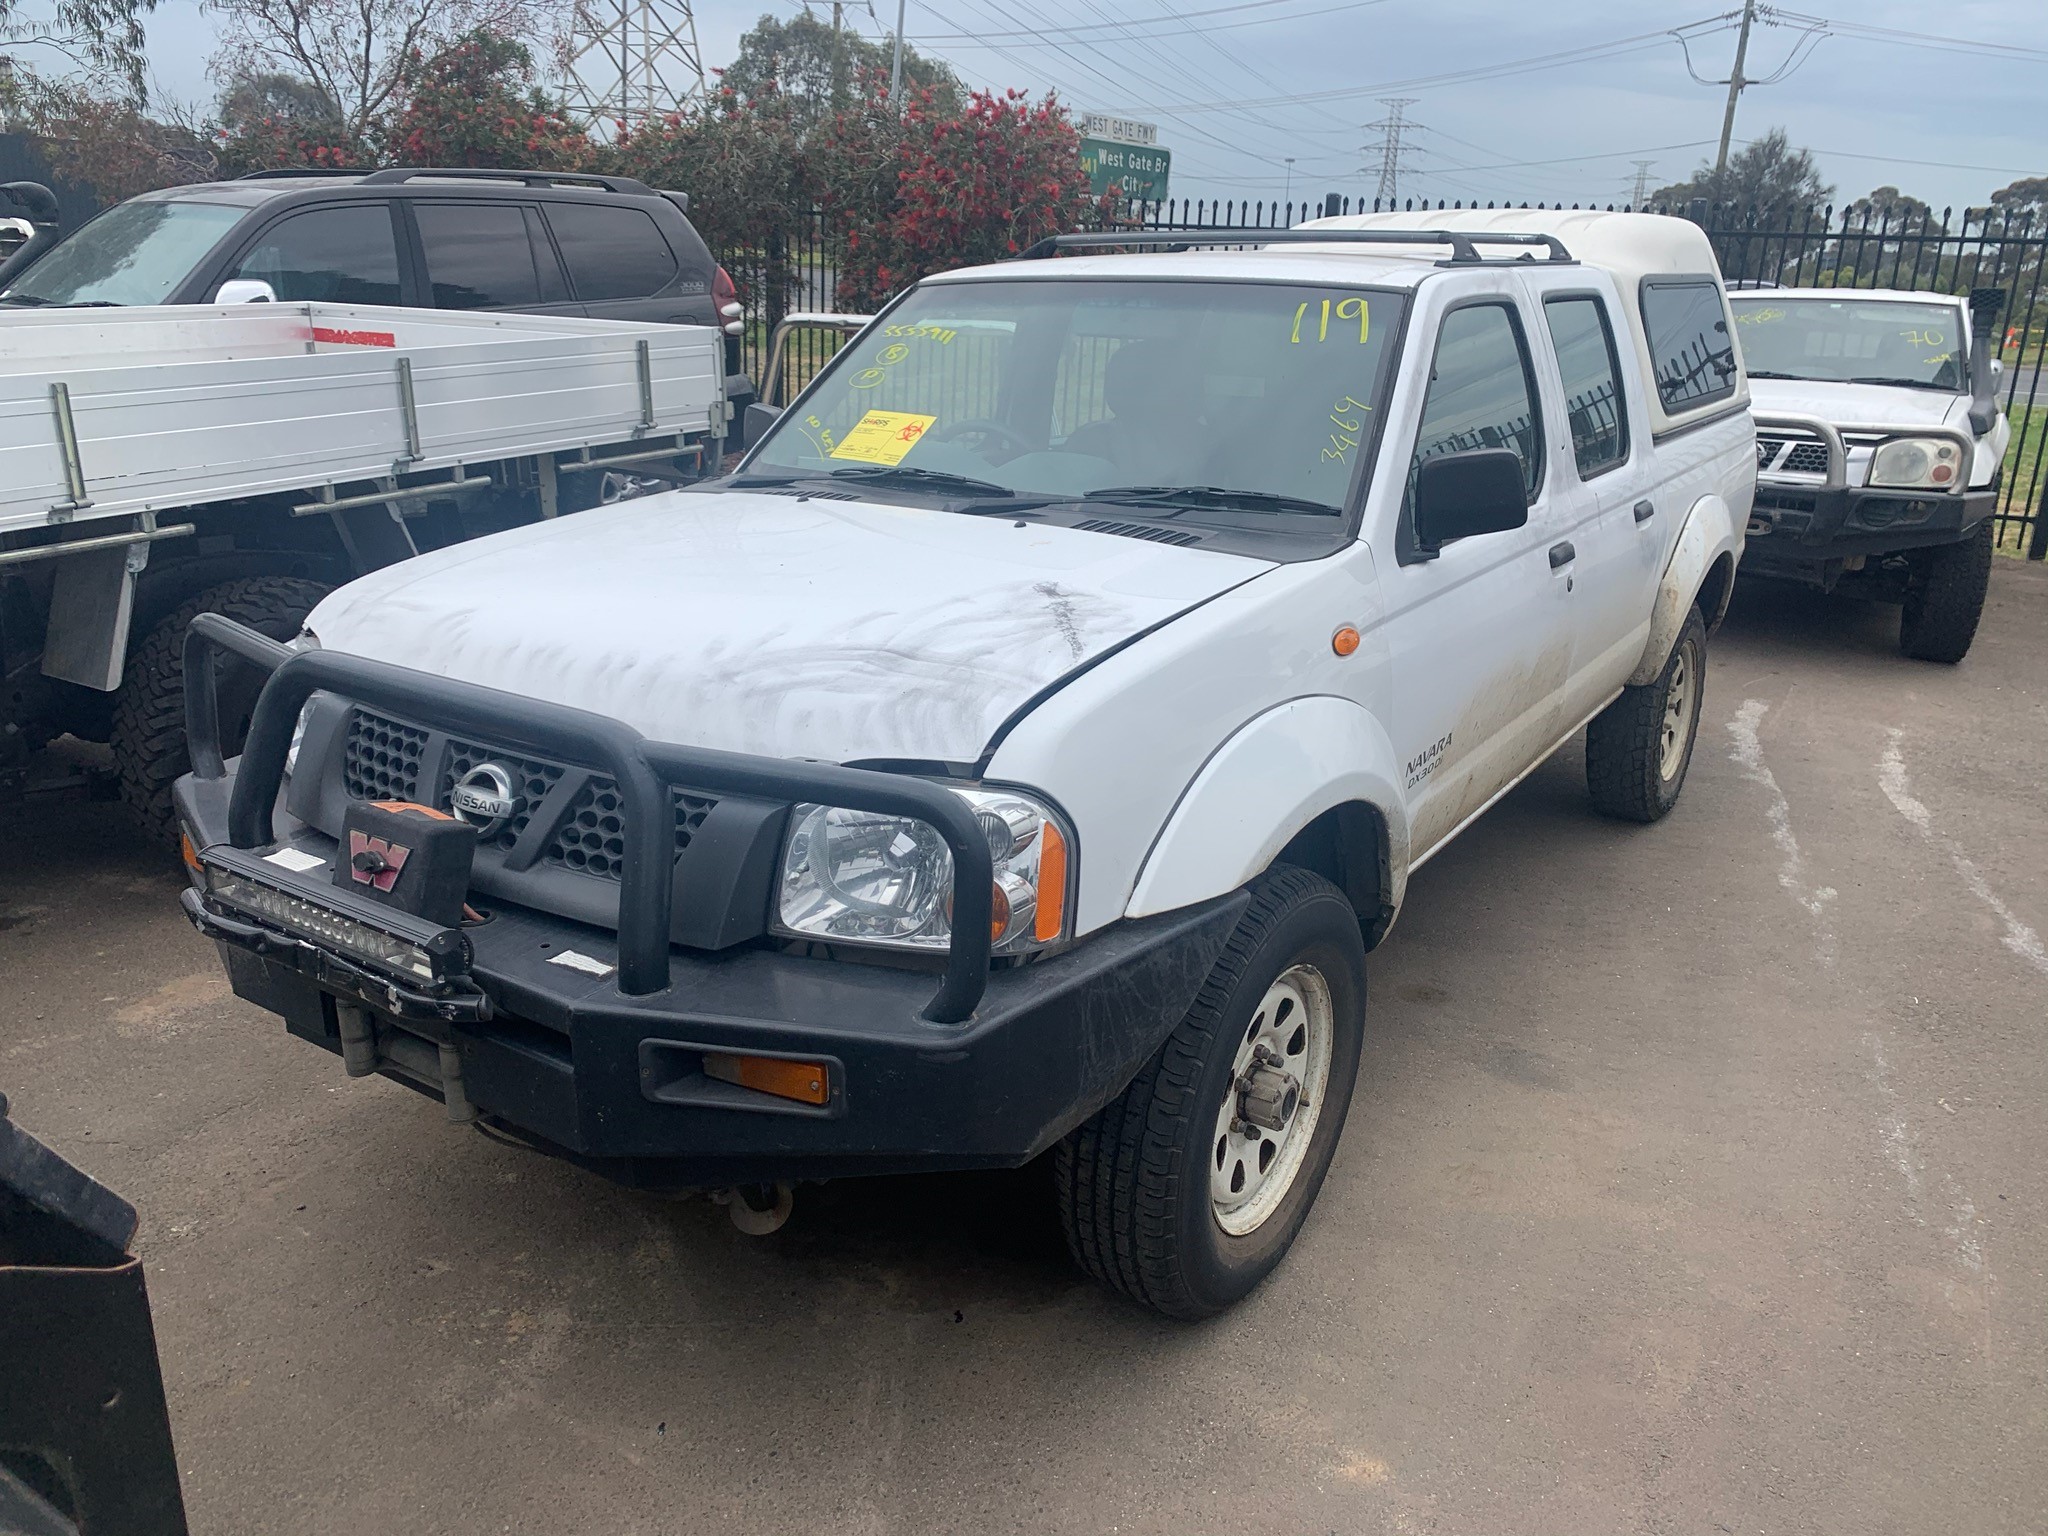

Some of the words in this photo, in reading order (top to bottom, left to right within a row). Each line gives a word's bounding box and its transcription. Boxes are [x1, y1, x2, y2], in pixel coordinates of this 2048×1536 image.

[1085, 115, 1108, 132] WEST
[1113, 120, 1134, 137] GATE
[1138, 124, 1155, 140] FWY
[1082, 156, 1097, 174] M1
[1098, 148, 1124, 168] West
[1128, 153, 1152, 172] Gate
[1155, 157, 1167, 173] Br
[1291, 298, 1369, 344] 119
[1899, 330, 1944, 349] 70
[1321, 395, 1373, 465] 3469
[1405, 732, 1452, 778] NAVARA
[452, 790, 501, 814] NISSAN
